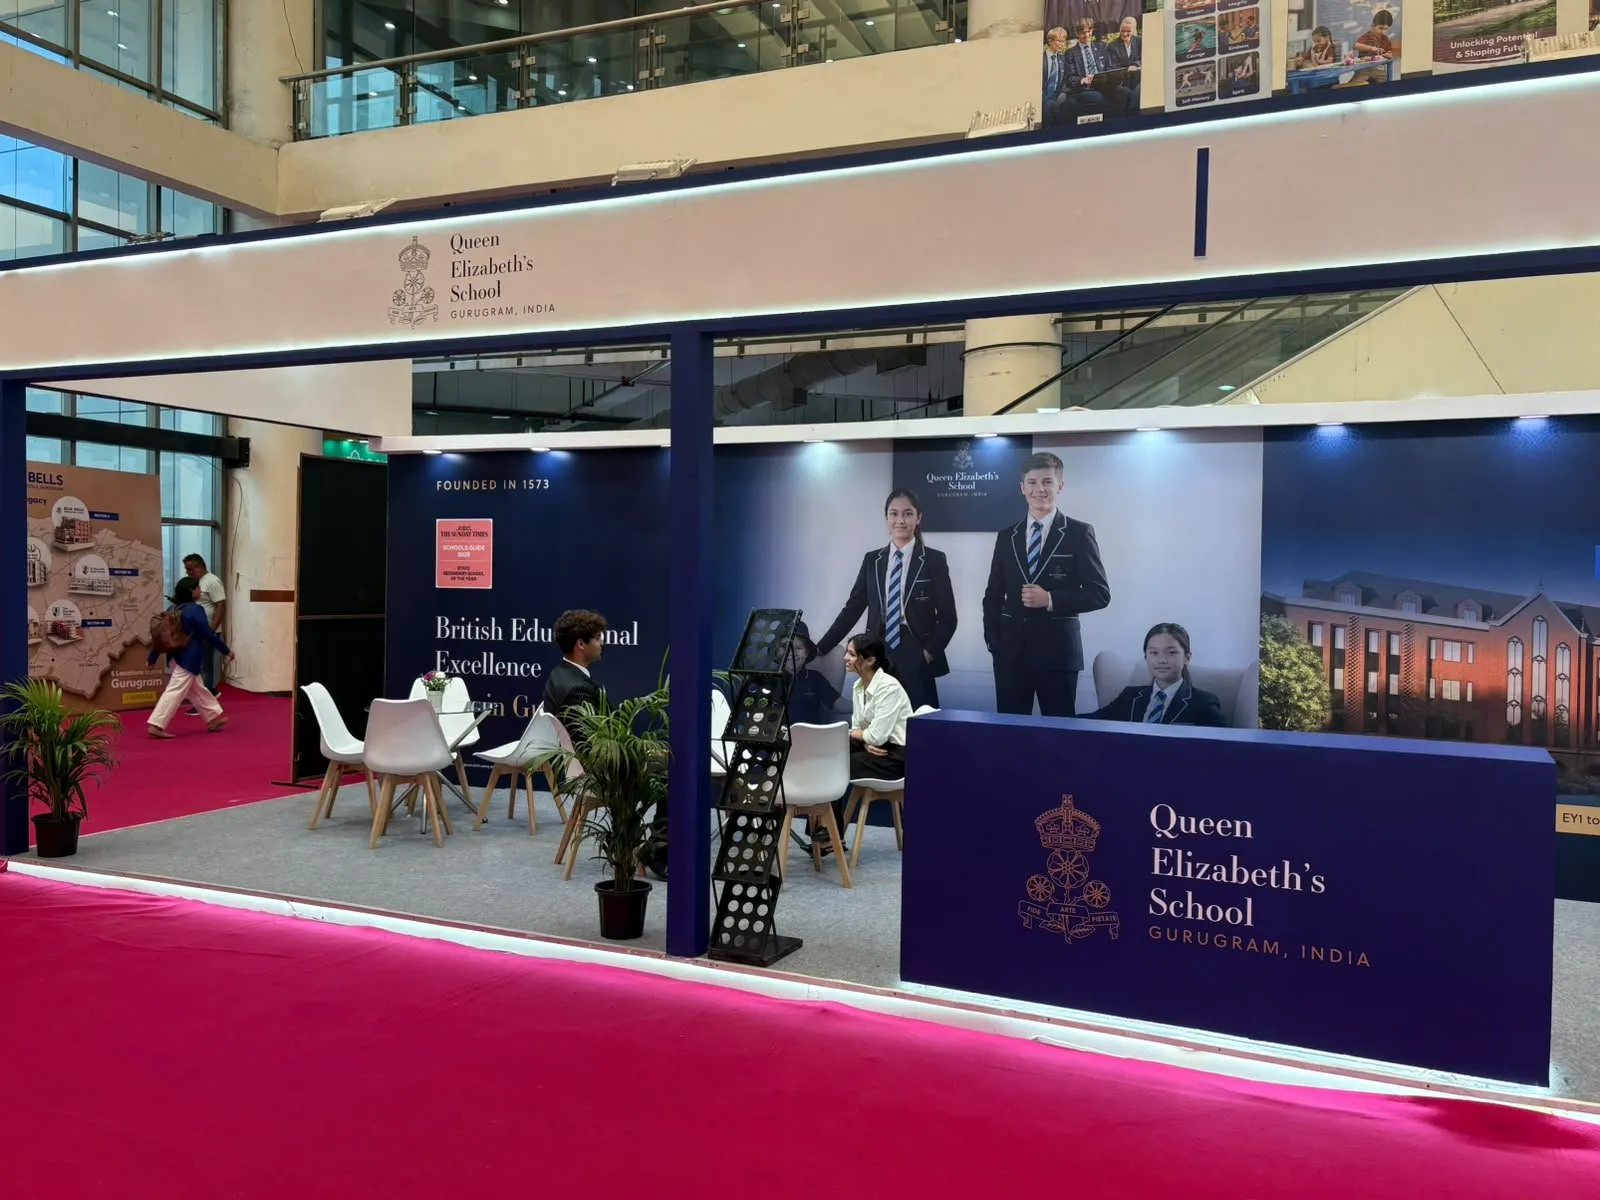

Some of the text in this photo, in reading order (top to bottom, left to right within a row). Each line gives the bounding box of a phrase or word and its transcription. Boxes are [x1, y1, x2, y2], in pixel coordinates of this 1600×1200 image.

[1450, 37, 1494, 49] Unlocking
[1455, 51, 1463, 59] &
[1464, 46, 1501, 58] Shaping
[450, 233, 500, 255] Queen
[450, 254, 533, 279] Elizabeth's
[450, 280, 501, 302] School
[450, 306, 518, 319] GURUGRAM,
[523, 303, 555, 314] INDIA
[28, 472, 63, 485] BELLS
[436, 479, 550, 491] FOUNDED IN 1573
[926, 471, 999, 483] Queen Elizabeth's
[948, 481, 976, 490] School
[435, 615, 640, 646] British Edunal
[435, 650, 542, 678] Excellence
[111, 678, 162, 689] Gurugram
[1150, 803, 1253, 839] Queen
[1562, 812, 1600, 825] EY1 to
[1151, 847, 1326, 893] Elizabeth's
[1027, 906, 1041, 915] FIDE
[1060, 906, 1076, 914] ARTE
[1149, 887, 1254, 927] School
[1149, 926, 1371, 968] GURUGRAM, INDIA
